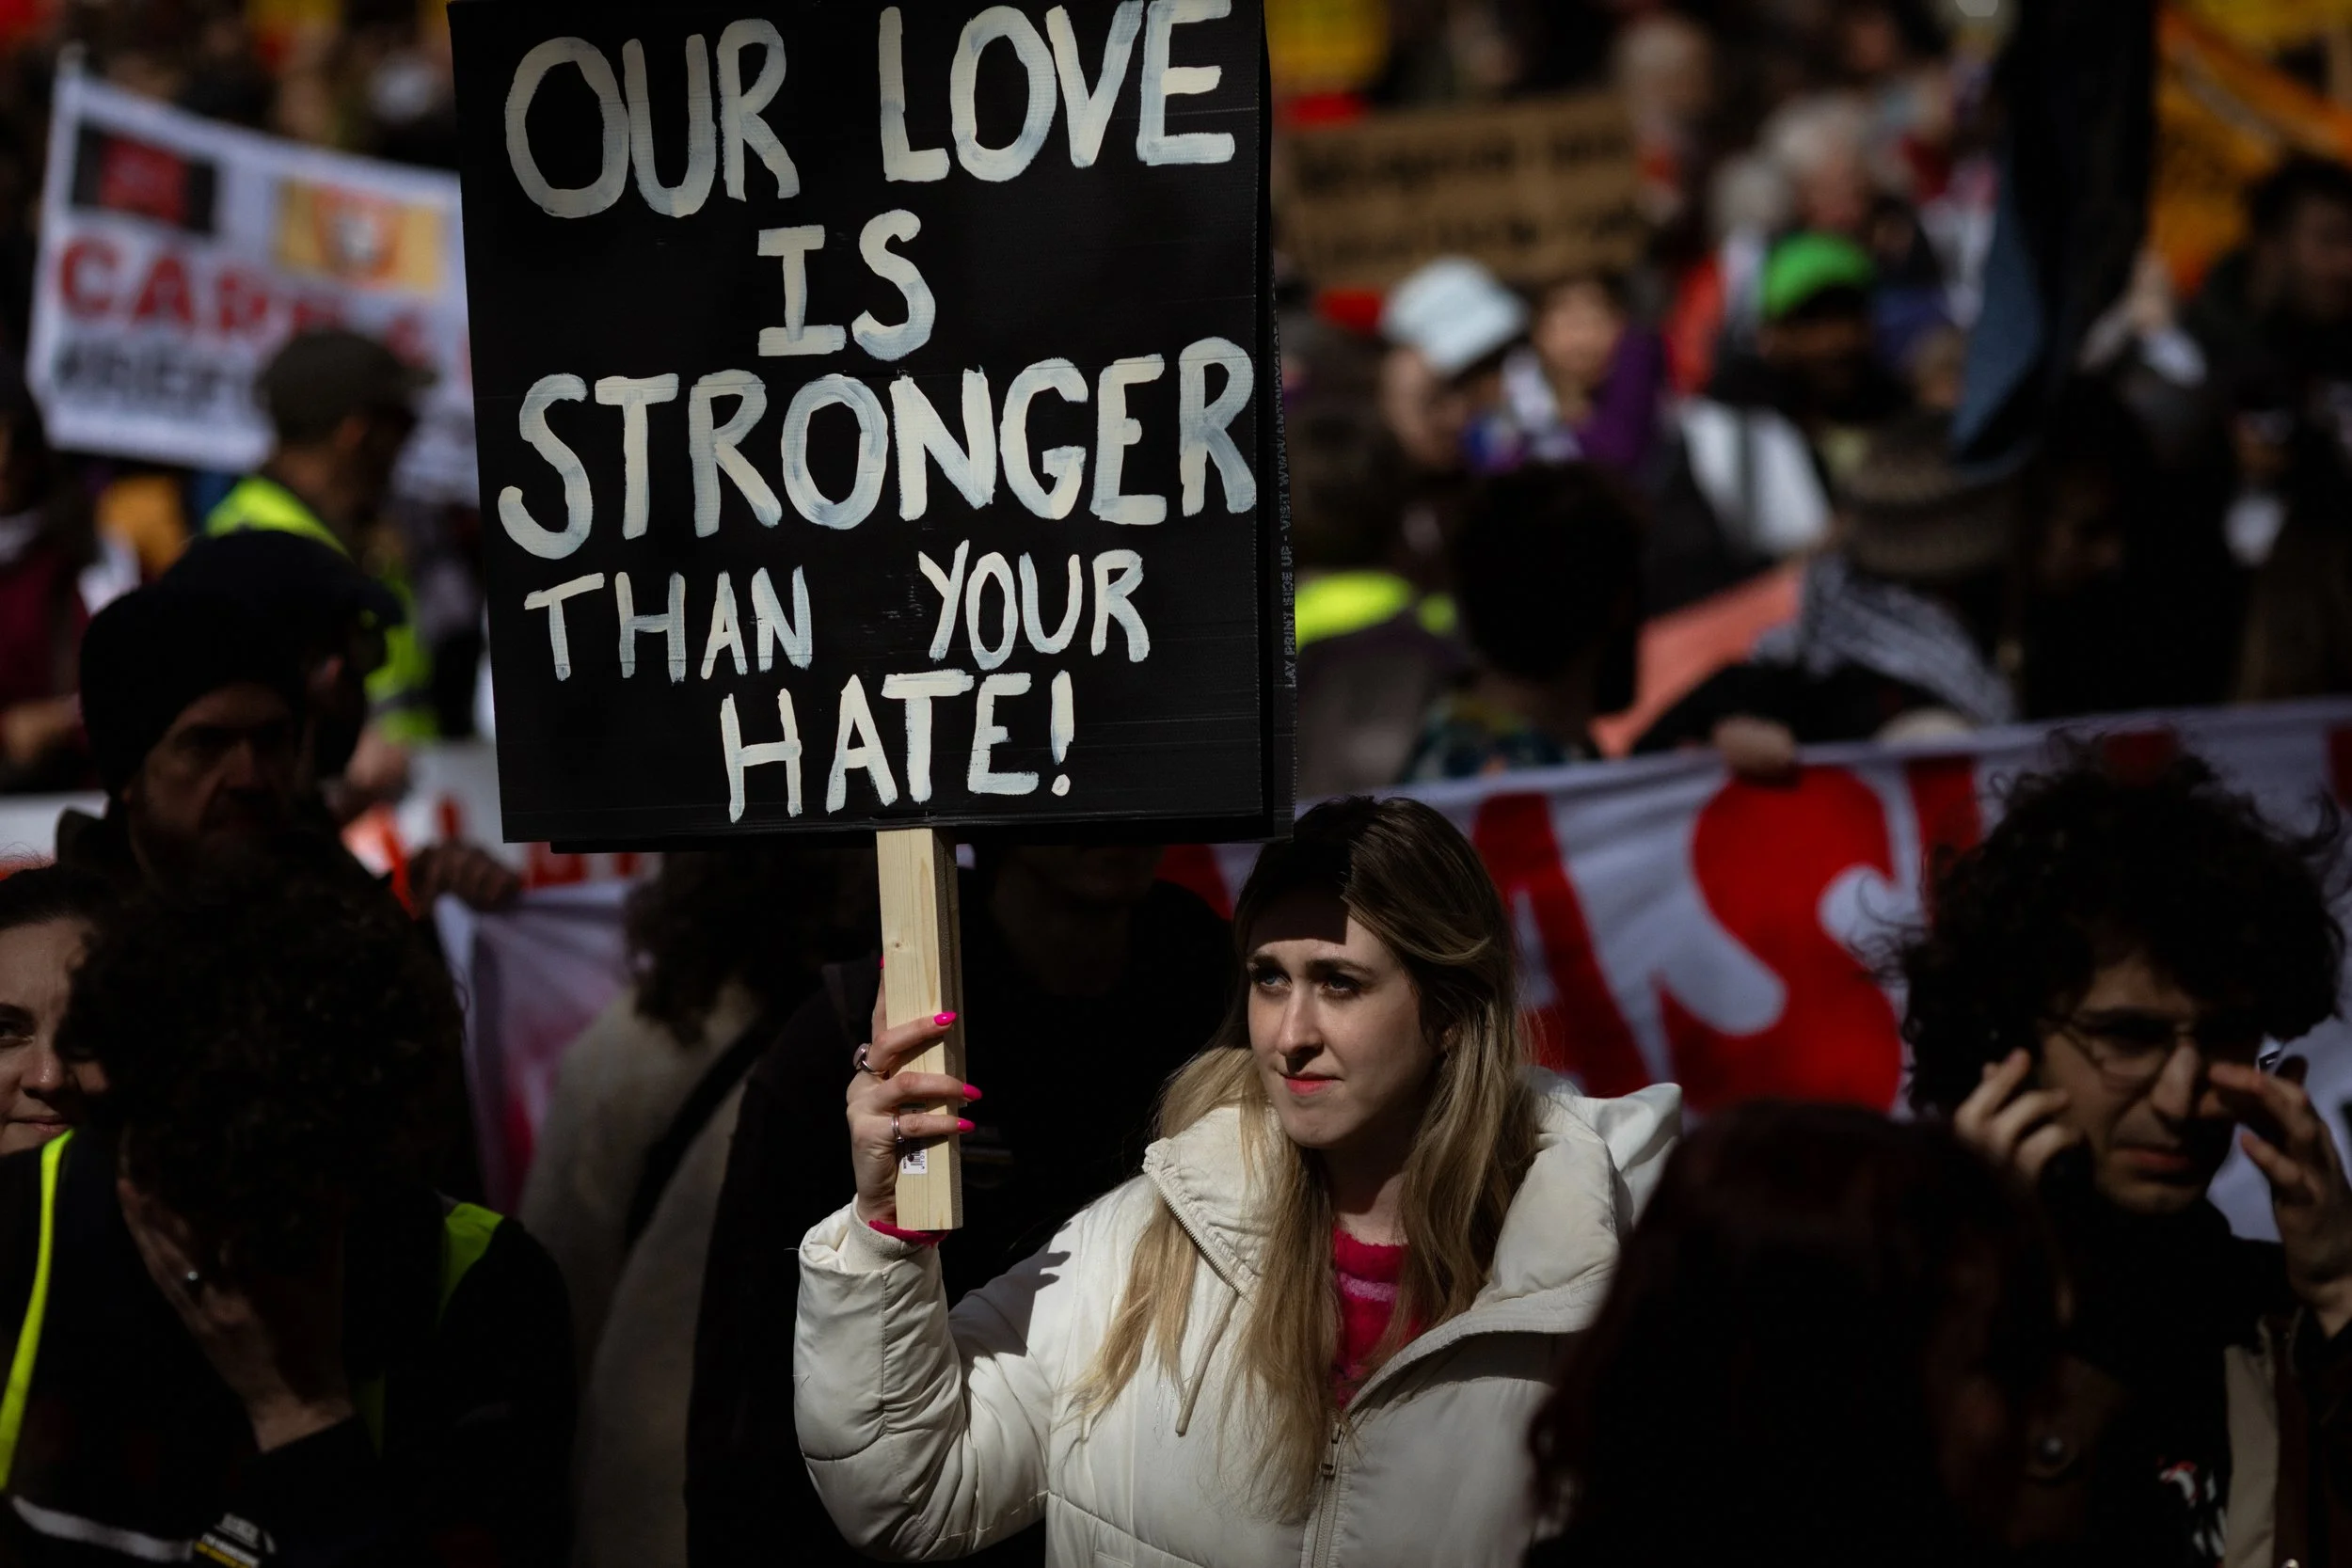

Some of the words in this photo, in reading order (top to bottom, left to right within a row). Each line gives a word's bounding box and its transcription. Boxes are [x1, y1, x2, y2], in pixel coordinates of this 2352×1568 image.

[505, 18, 800, 218] OUR
[879, 0, 1236, 182] LOVE
[757, 209, 936, 361] IS
[498, 337, 1257, 560] STRONGER
[1279, 491, 1292, 532] VISIT
[1280, 545, 1293, 568] UP
[524, 565, 813, 684] THAN
[918, 539, 1150, 671] YOUR
[1280, 571, 1295, 607] SIDE
[1282, 612, 1295, 656] PRINT
[1282, 659, 1296, 689] LAY
[721, 669, 1075, 824] HATE!
